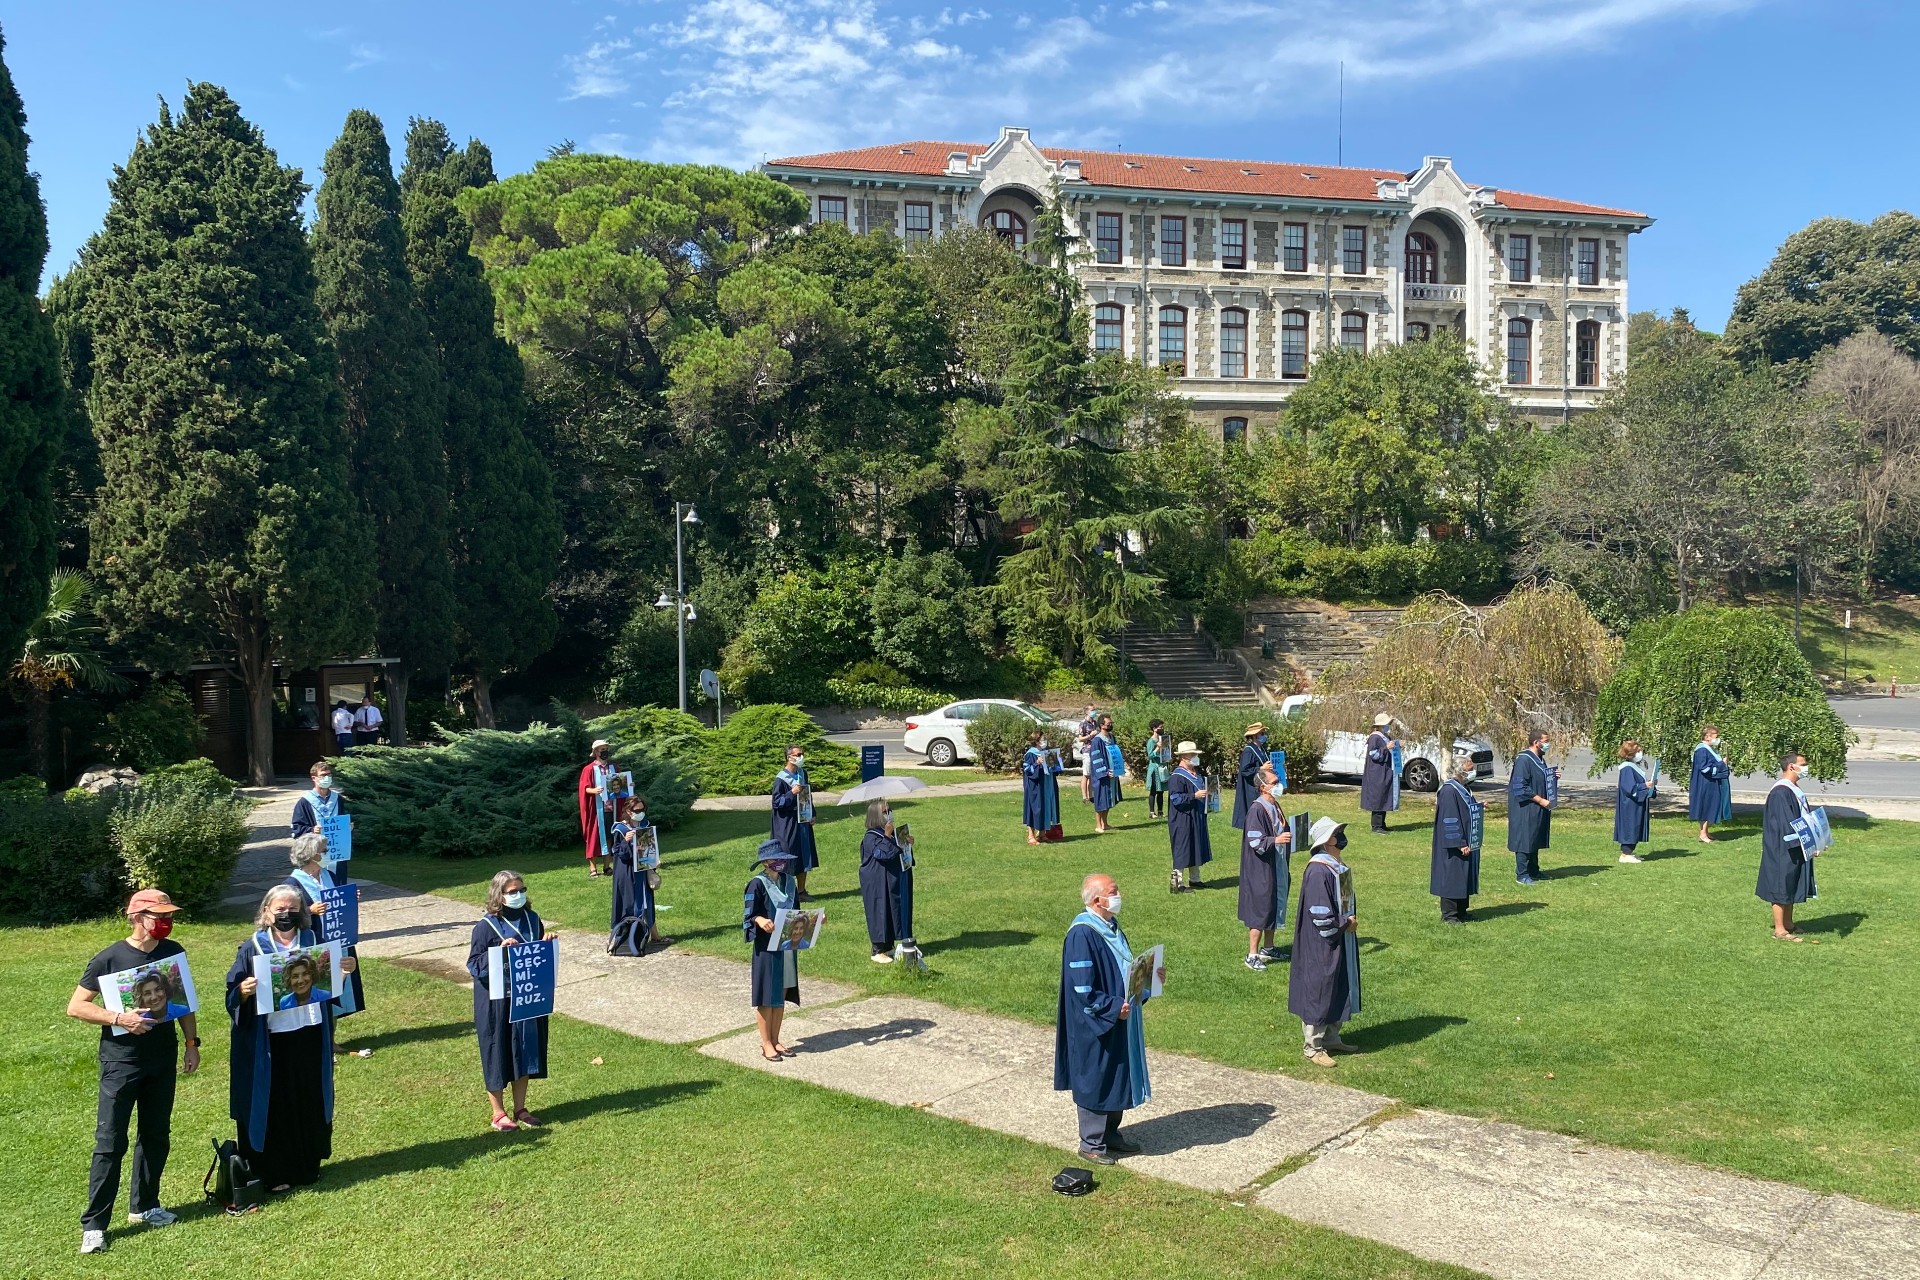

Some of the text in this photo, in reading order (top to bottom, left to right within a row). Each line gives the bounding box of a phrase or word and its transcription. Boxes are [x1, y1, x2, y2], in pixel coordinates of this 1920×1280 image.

[324, 890, 344, 900] KA-
[325, 899, 346, 910] BUL
[326, 910, 343, 920] ET-
[326, 918, 344, 930] Mİ-
[326, 930, 346, 940] YO-
[513, 944, 546, 957] VAZ-
[514, 956, 546, 970] GEÇ-
[515, 968, 536, 982] Mİ-
[516, 982, 538, 994] YO-
[515, 993, 546, 1006] RUZ.
